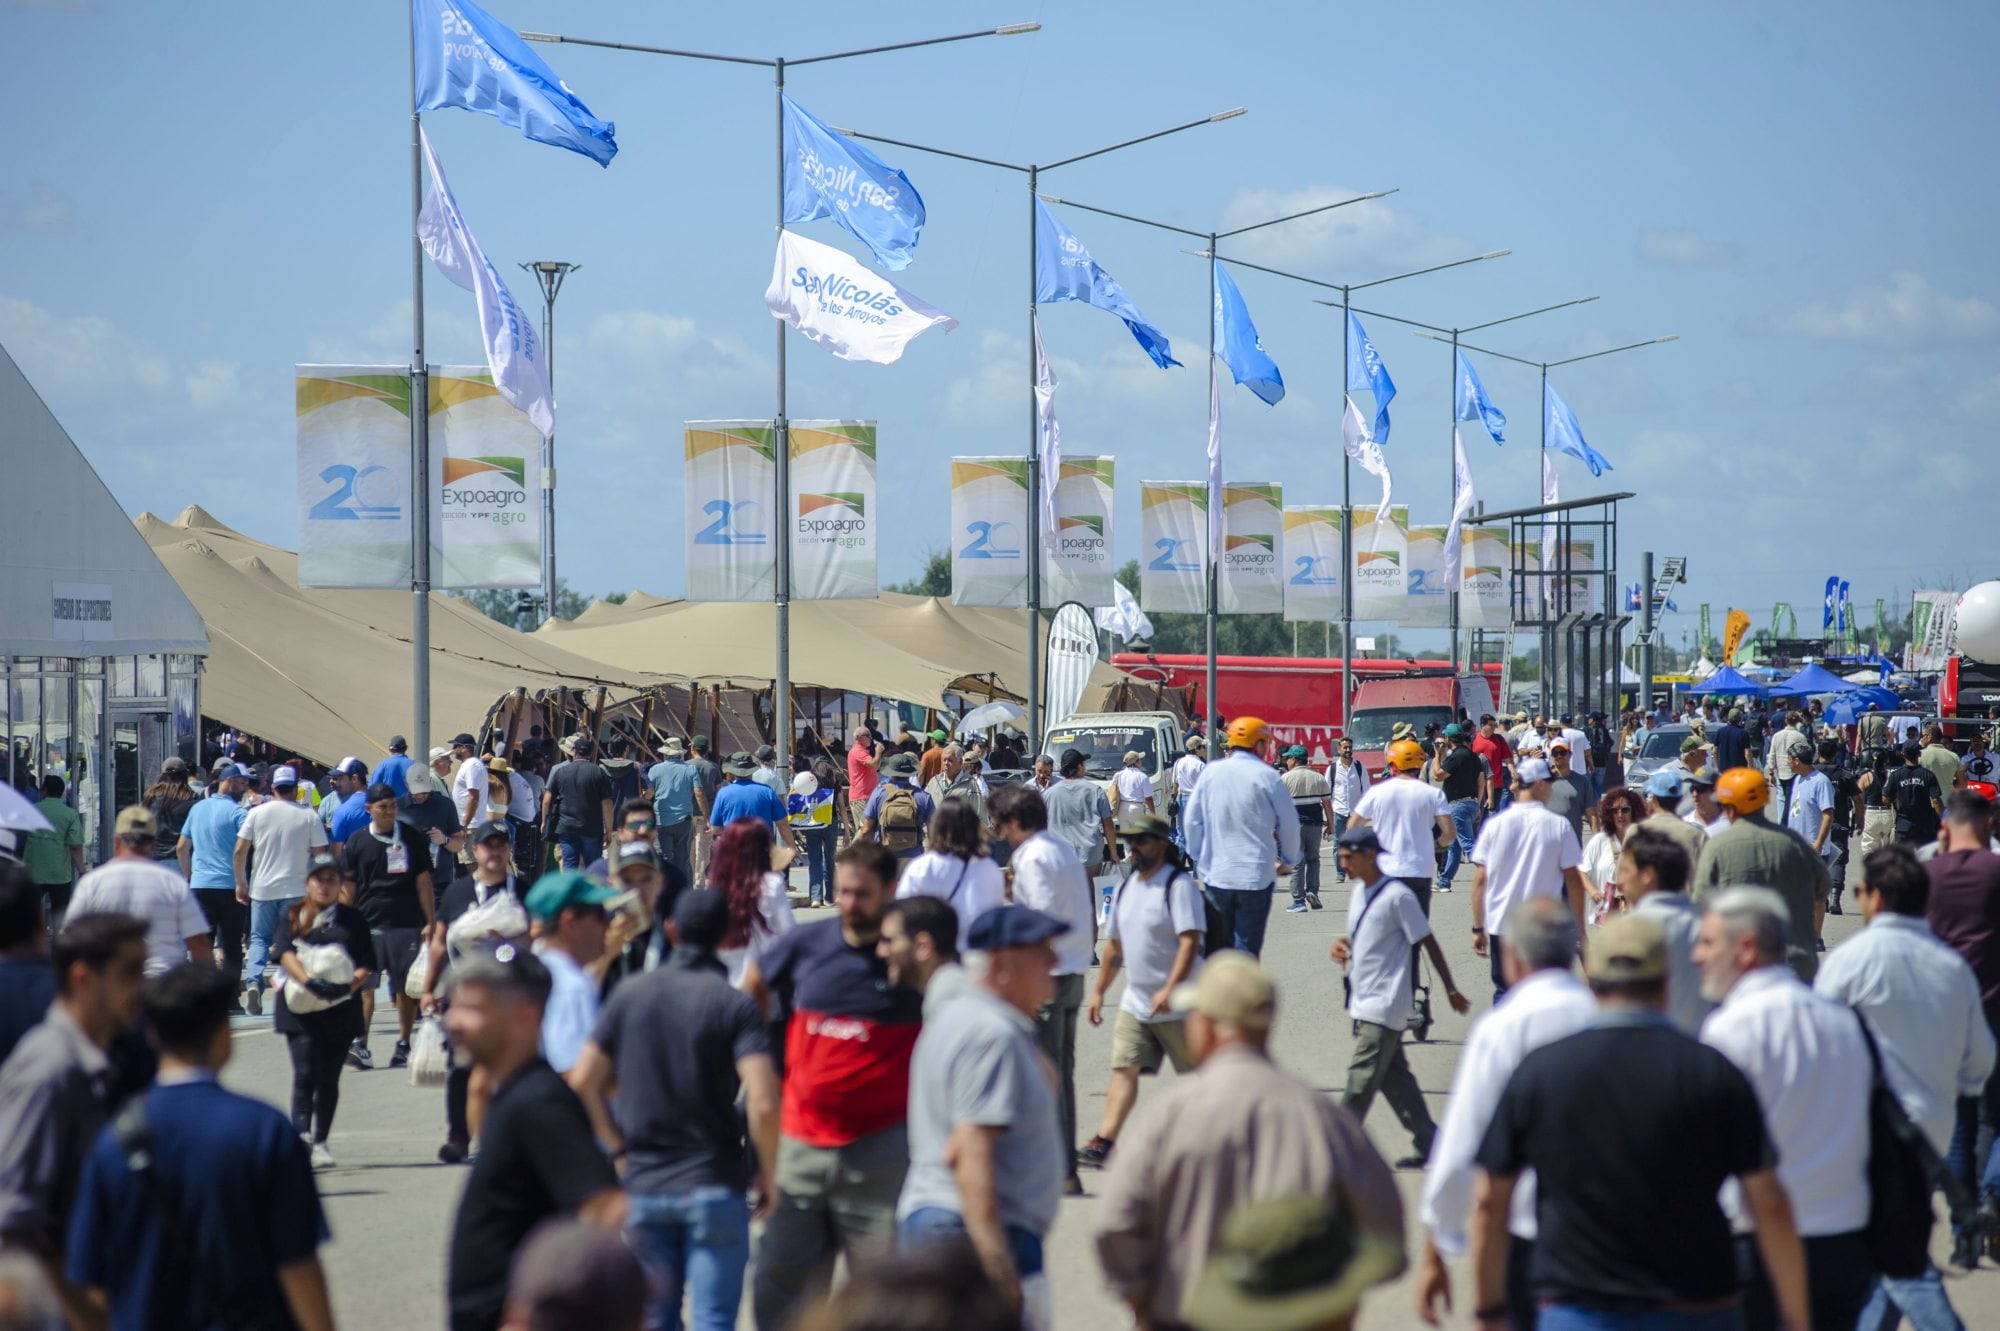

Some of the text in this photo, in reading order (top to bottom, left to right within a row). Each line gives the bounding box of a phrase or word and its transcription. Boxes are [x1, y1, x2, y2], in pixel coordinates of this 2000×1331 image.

[822, 273, 903, 317] Nicolás
[829, 300, 844, 315] los
[844, 306, 887, 326] Arroyos
[442, 488, 526, 508] Expoagro
[492, 512, 526, 526] agro
[799, 519, 866, 535] Expoagro
[838, 537, 866, 549] agro
[1062, 538, 1105, 551] poagro
[1081, 553, 1105, 563] agro
[1224, 553, 1275, 565] Expoagro
[1357, 568, 1401, 579] Expoagro
[1063, 728, 1144, 737] LTA MOTORS
